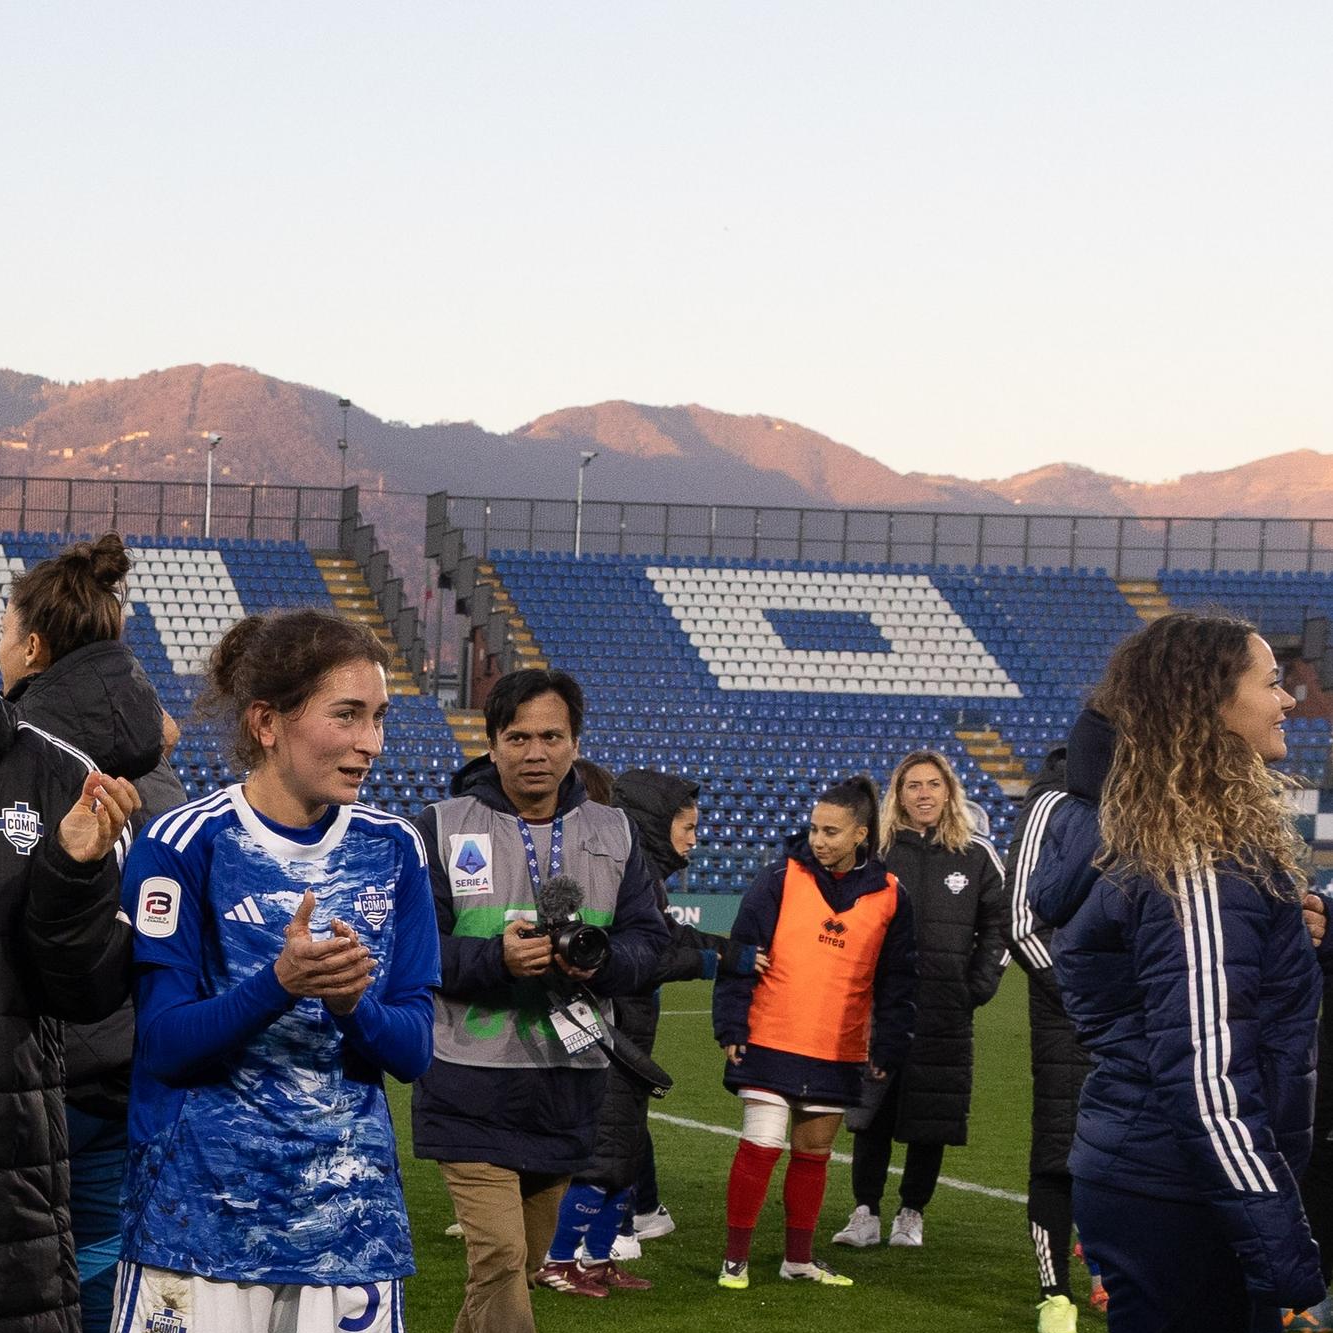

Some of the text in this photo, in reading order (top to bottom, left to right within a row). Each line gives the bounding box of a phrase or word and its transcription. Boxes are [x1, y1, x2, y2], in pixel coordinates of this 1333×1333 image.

[7, 818, 36, 833] COMO
[455, 879, 483, 888] SERIE
[362, 900, 386, 911] COMO
[665, 906, 700, 925] ON
